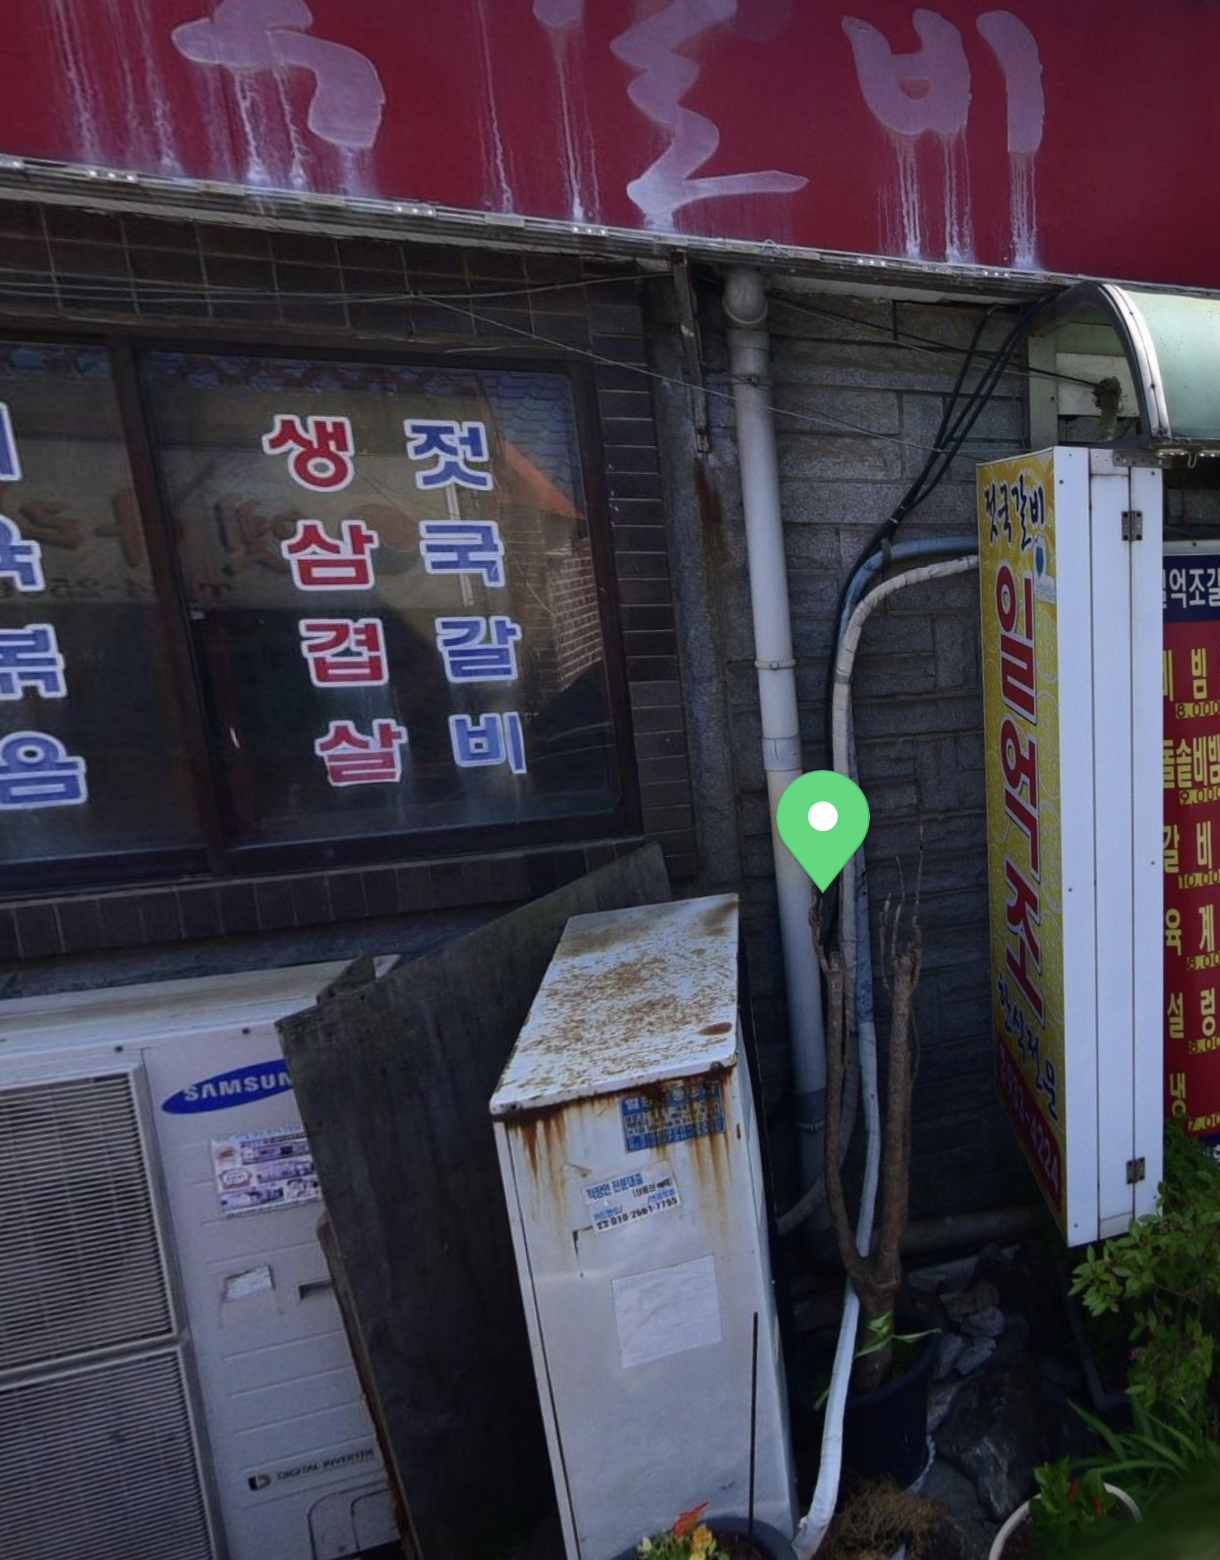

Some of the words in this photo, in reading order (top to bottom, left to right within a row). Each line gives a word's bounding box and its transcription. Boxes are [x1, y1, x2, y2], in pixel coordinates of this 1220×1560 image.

[263, 414, 408, 787] 생삼겹살
[404, 419, 527, 775] 젓국갈비
[984, 474, 1046, 551] 젓국갈비
[996, 561, 1045, 1027] 일억조
